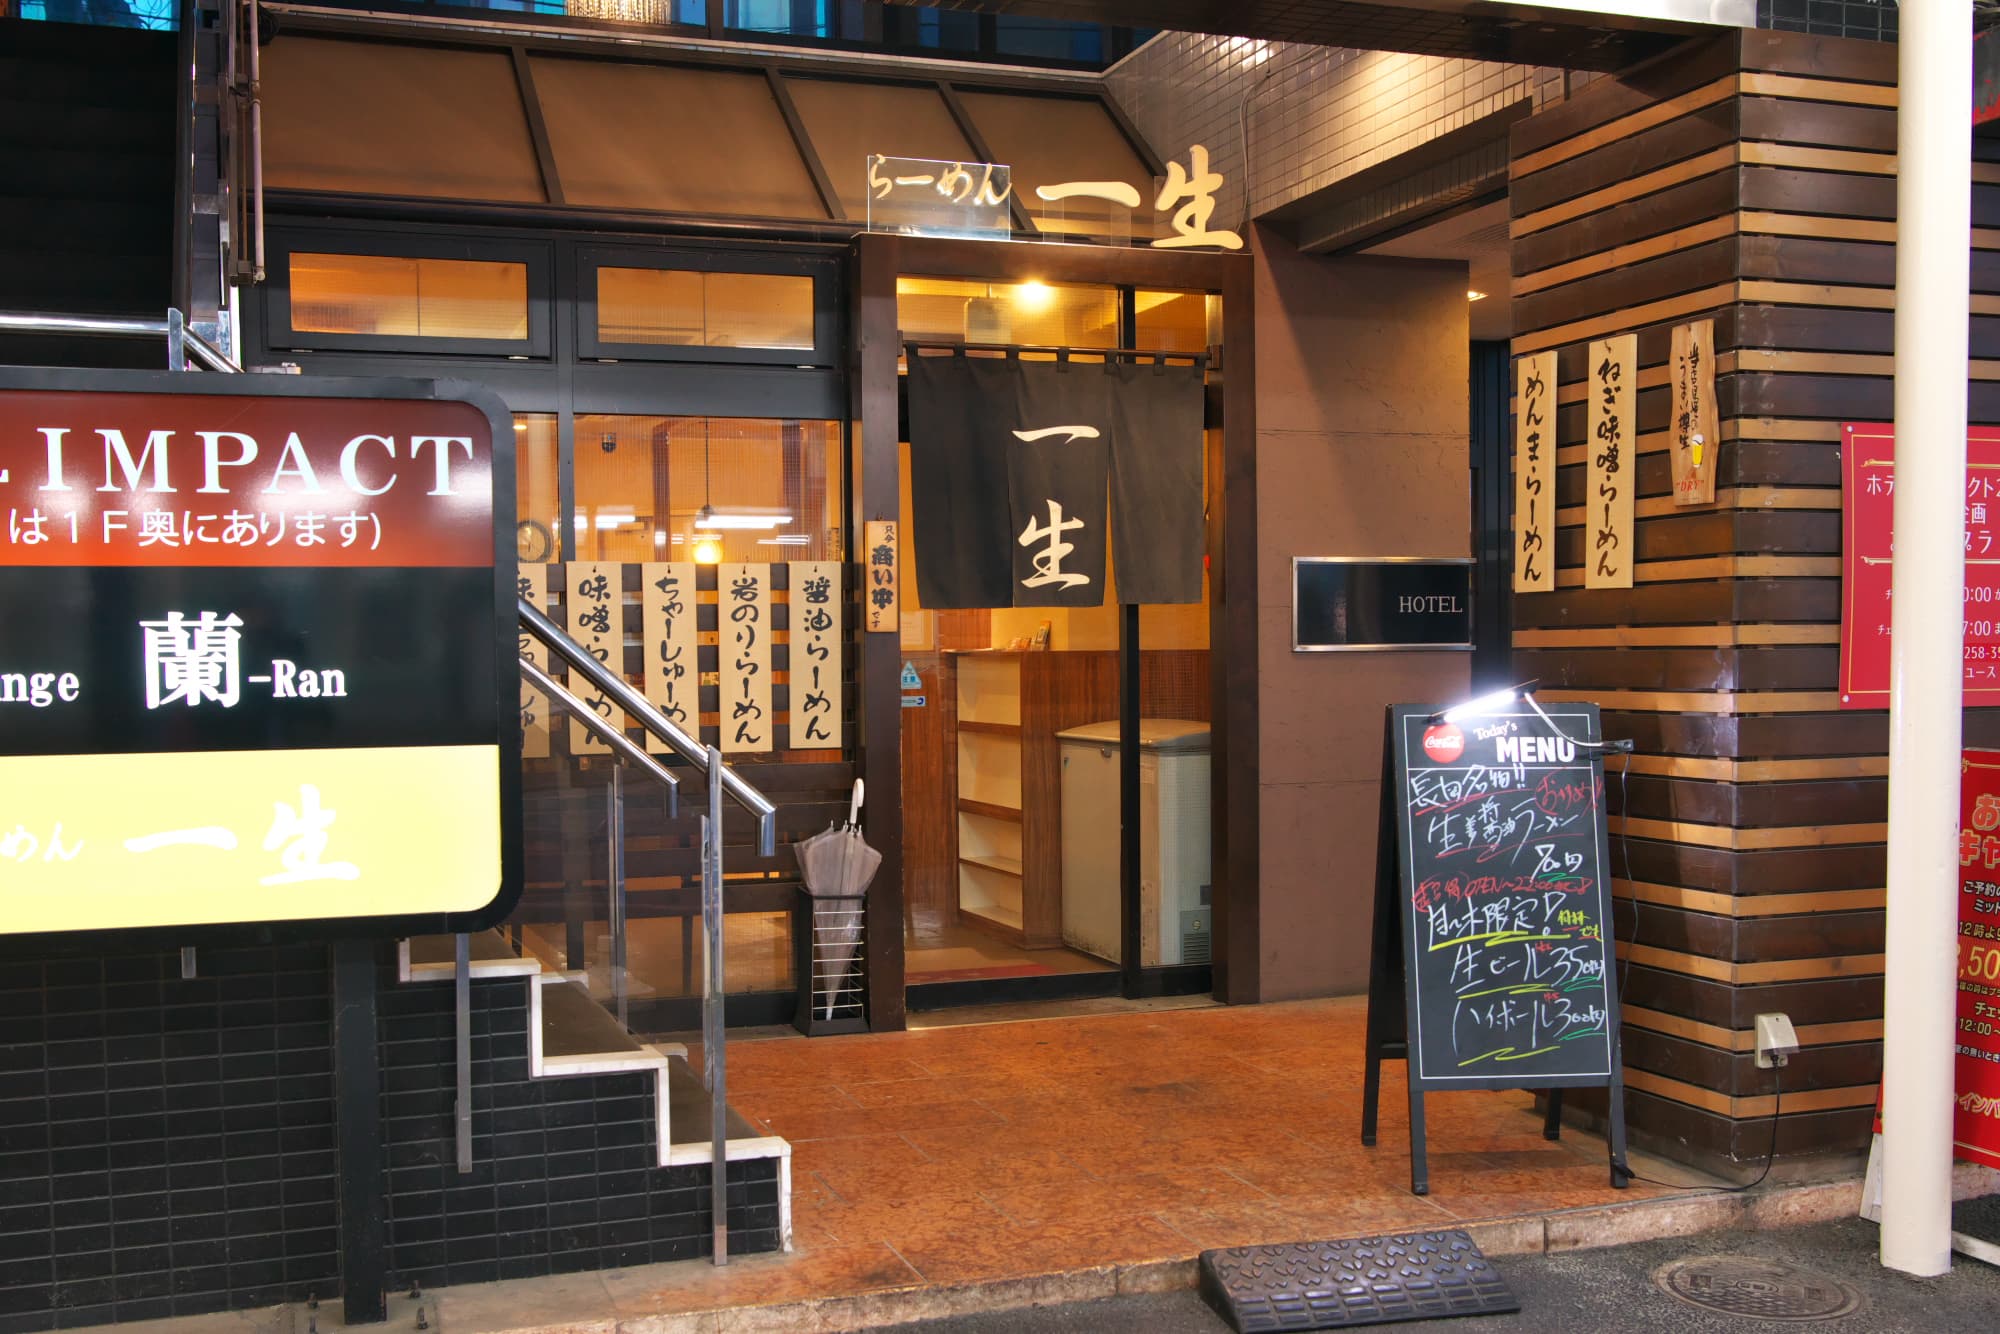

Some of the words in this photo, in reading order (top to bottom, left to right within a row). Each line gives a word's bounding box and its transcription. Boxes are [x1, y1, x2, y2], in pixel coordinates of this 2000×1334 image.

[868, 153, 1012, 205] らーめん
[1036, 144, 1243, 249] 一生
[37, 427, 473, 496] IMPACT
[1012, 425, 1100, 591] 一生
[1523, 371, 1544, 581] めんまらーめん
[1596, 358, 1621, 577] ねぎ味噌らーめん
[872, 544, 895, 610] 商い中
[1399, 596, 1463, 613] HOTEL
[655, 576, 686, 724] ちゃーしゅーめ
[731, 578, 762, 744] 岩のりらーめん
[1473, 720, 1518, 741] Today's
[1496, 736, 1576, 763] MENU
[124, 783, 361, 885] 一生
